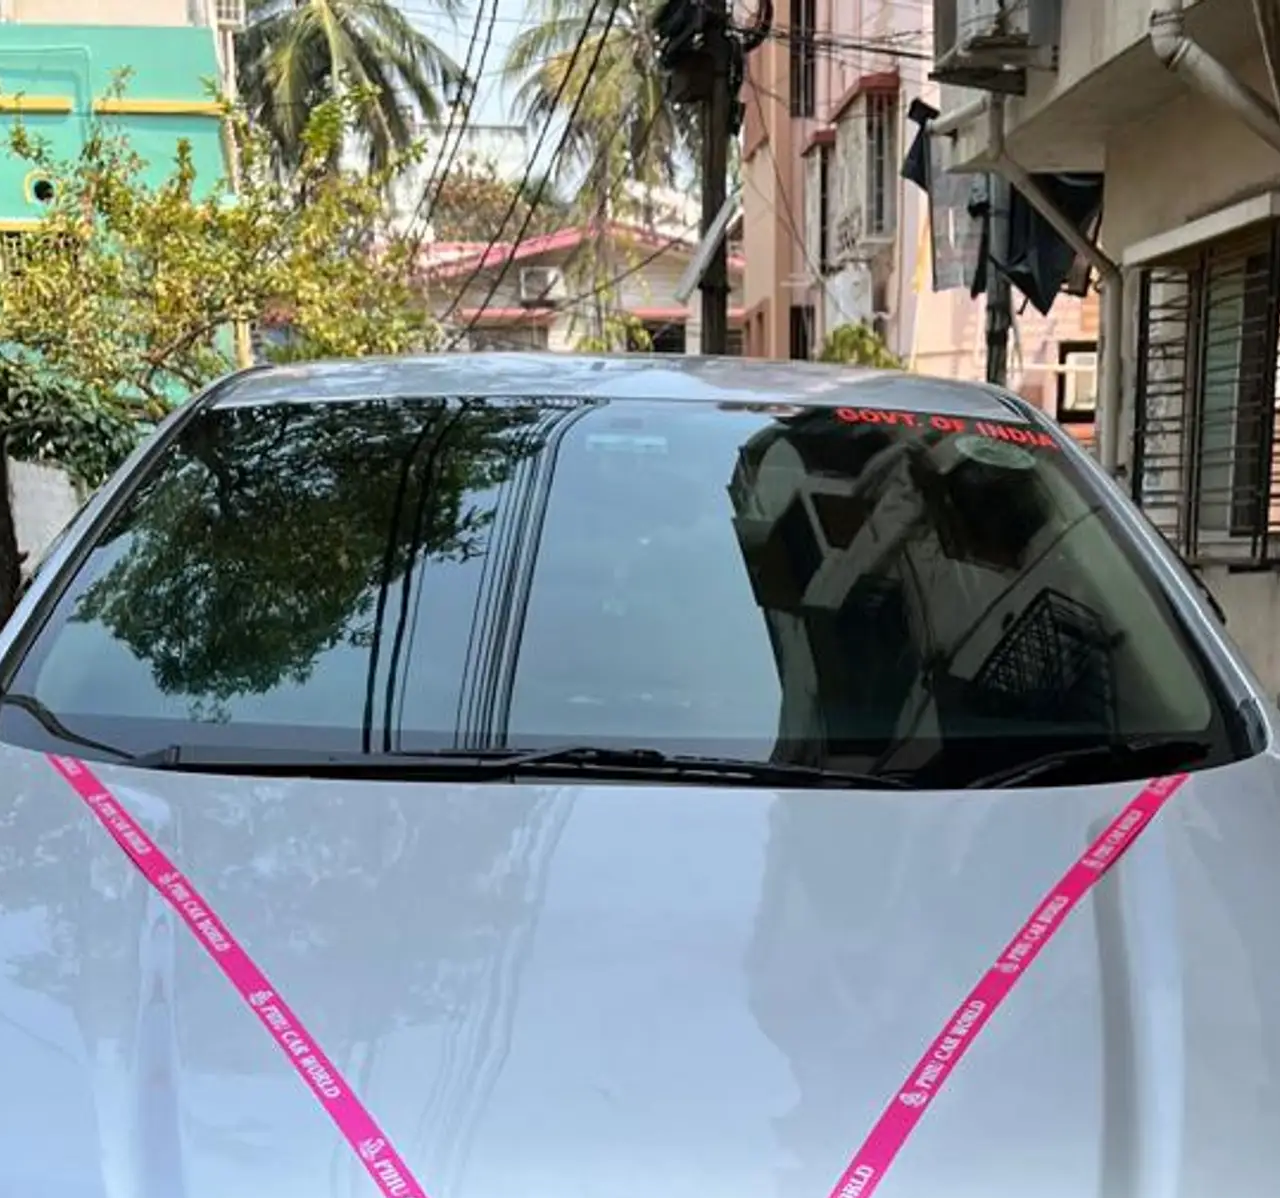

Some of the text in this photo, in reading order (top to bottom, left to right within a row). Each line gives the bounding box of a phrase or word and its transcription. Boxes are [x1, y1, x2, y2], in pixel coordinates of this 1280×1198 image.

[835, 406, 1060, 449] GOVT. OF INDIA
